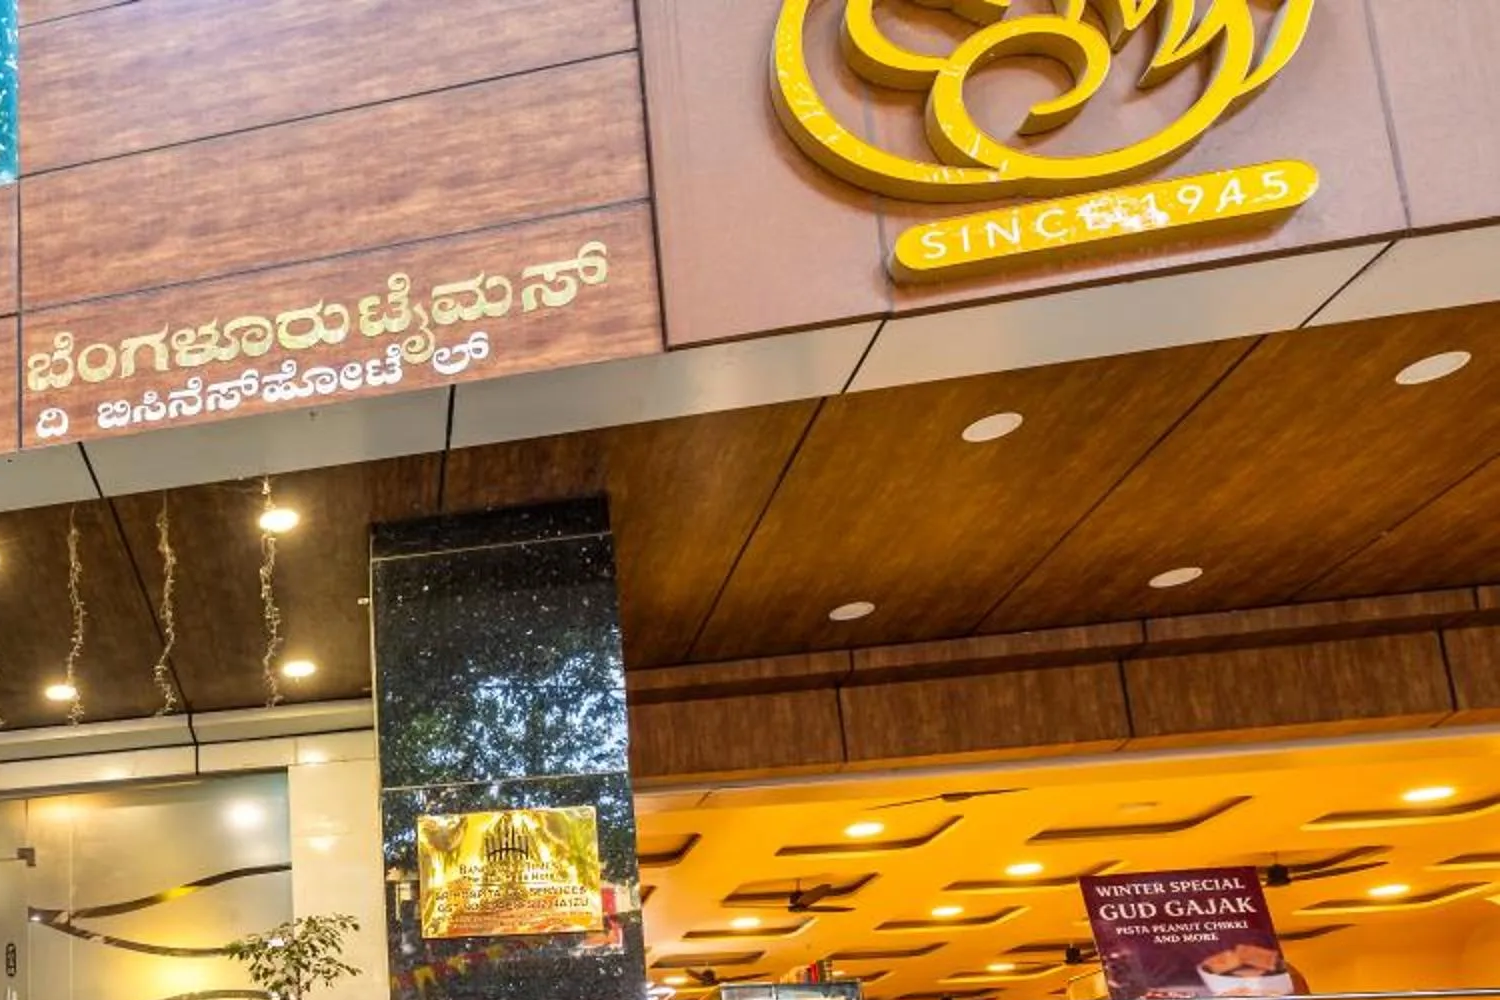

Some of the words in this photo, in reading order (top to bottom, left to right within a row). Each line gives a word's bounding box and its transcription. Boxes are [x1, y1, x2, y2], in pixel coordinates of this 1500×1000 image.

[920, 202, 1113, 260] SINCE
[1141, 170, 1290, 226] 1945
[1095, 882, 1166, 898] WINTER
[1169, 877, 1247, 894] SPECIAL
[1099, 901, 1158, 922] GUD
[1163, 895, 1258, 918] GAJAK
[1116, 925, 1151, 936] PISTA
[1152, 922, 1201, 934] PEANUT
[1153, 934, 1181, 945] AND
[1183, 932, 1220, 943] MORE
